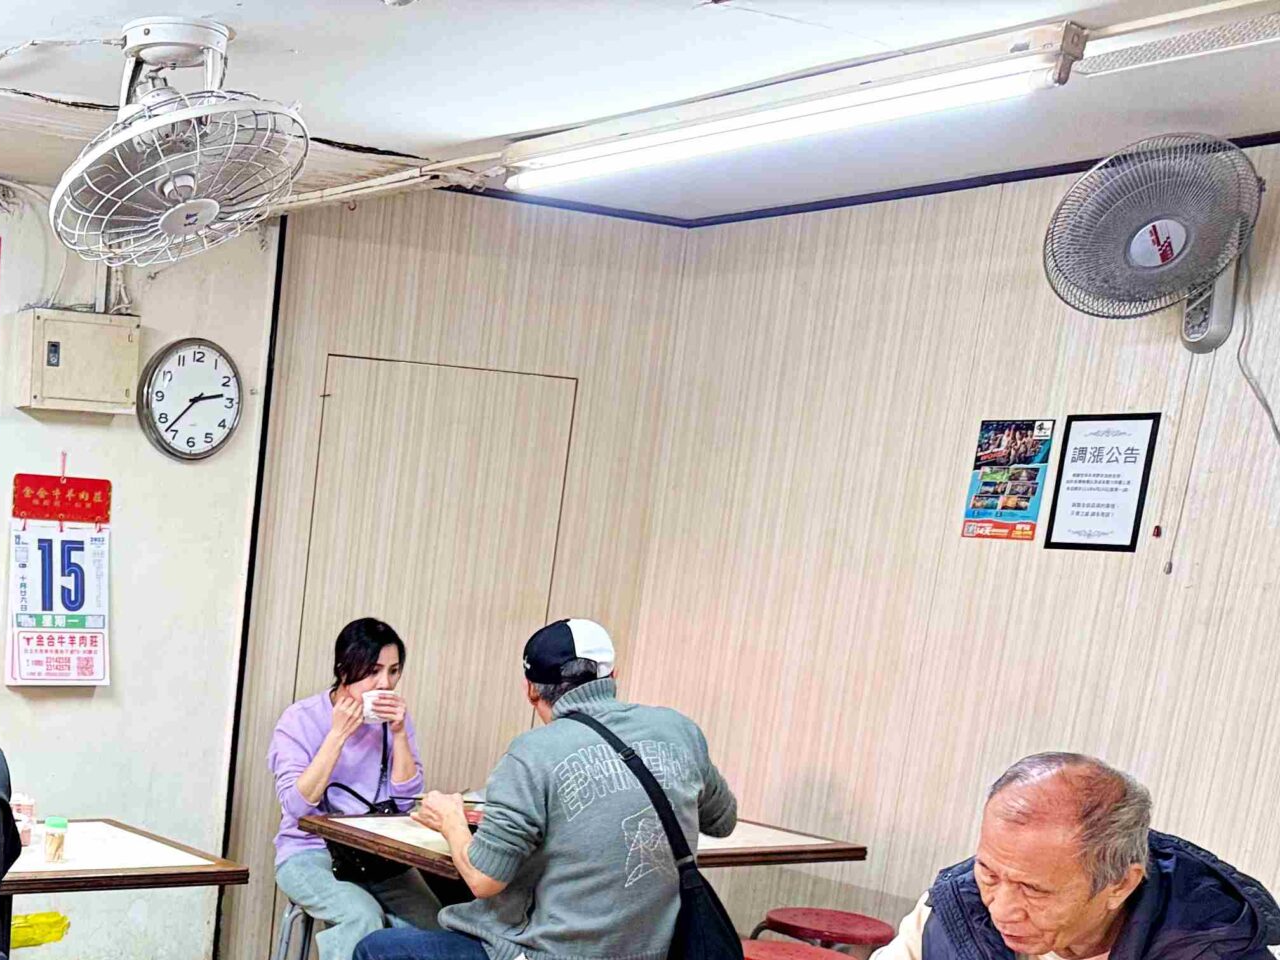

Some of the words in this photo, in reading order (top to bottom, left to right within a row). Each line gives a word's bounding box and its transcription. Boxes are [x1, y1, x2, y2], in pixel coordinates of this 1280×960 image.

[178, 354, 185, 367] 11
[193, 351, 205, 363] 12
[214, 359, 218, 370] 1
[222, 376, 231, 387] 2
[155, 390, 165, 401] 9
[224, 398, 234, 409] 3
[158, 413, 168, 424] 8
[218, 419, 226, 429] 4
[170, 430, 178, 440] 7
[204, 433, 213, 443] 5
[186, 437, 195, 448] 6
[1070, 446, 1141, 465] 調漲公告
[38, 538, 86, 612] 15
